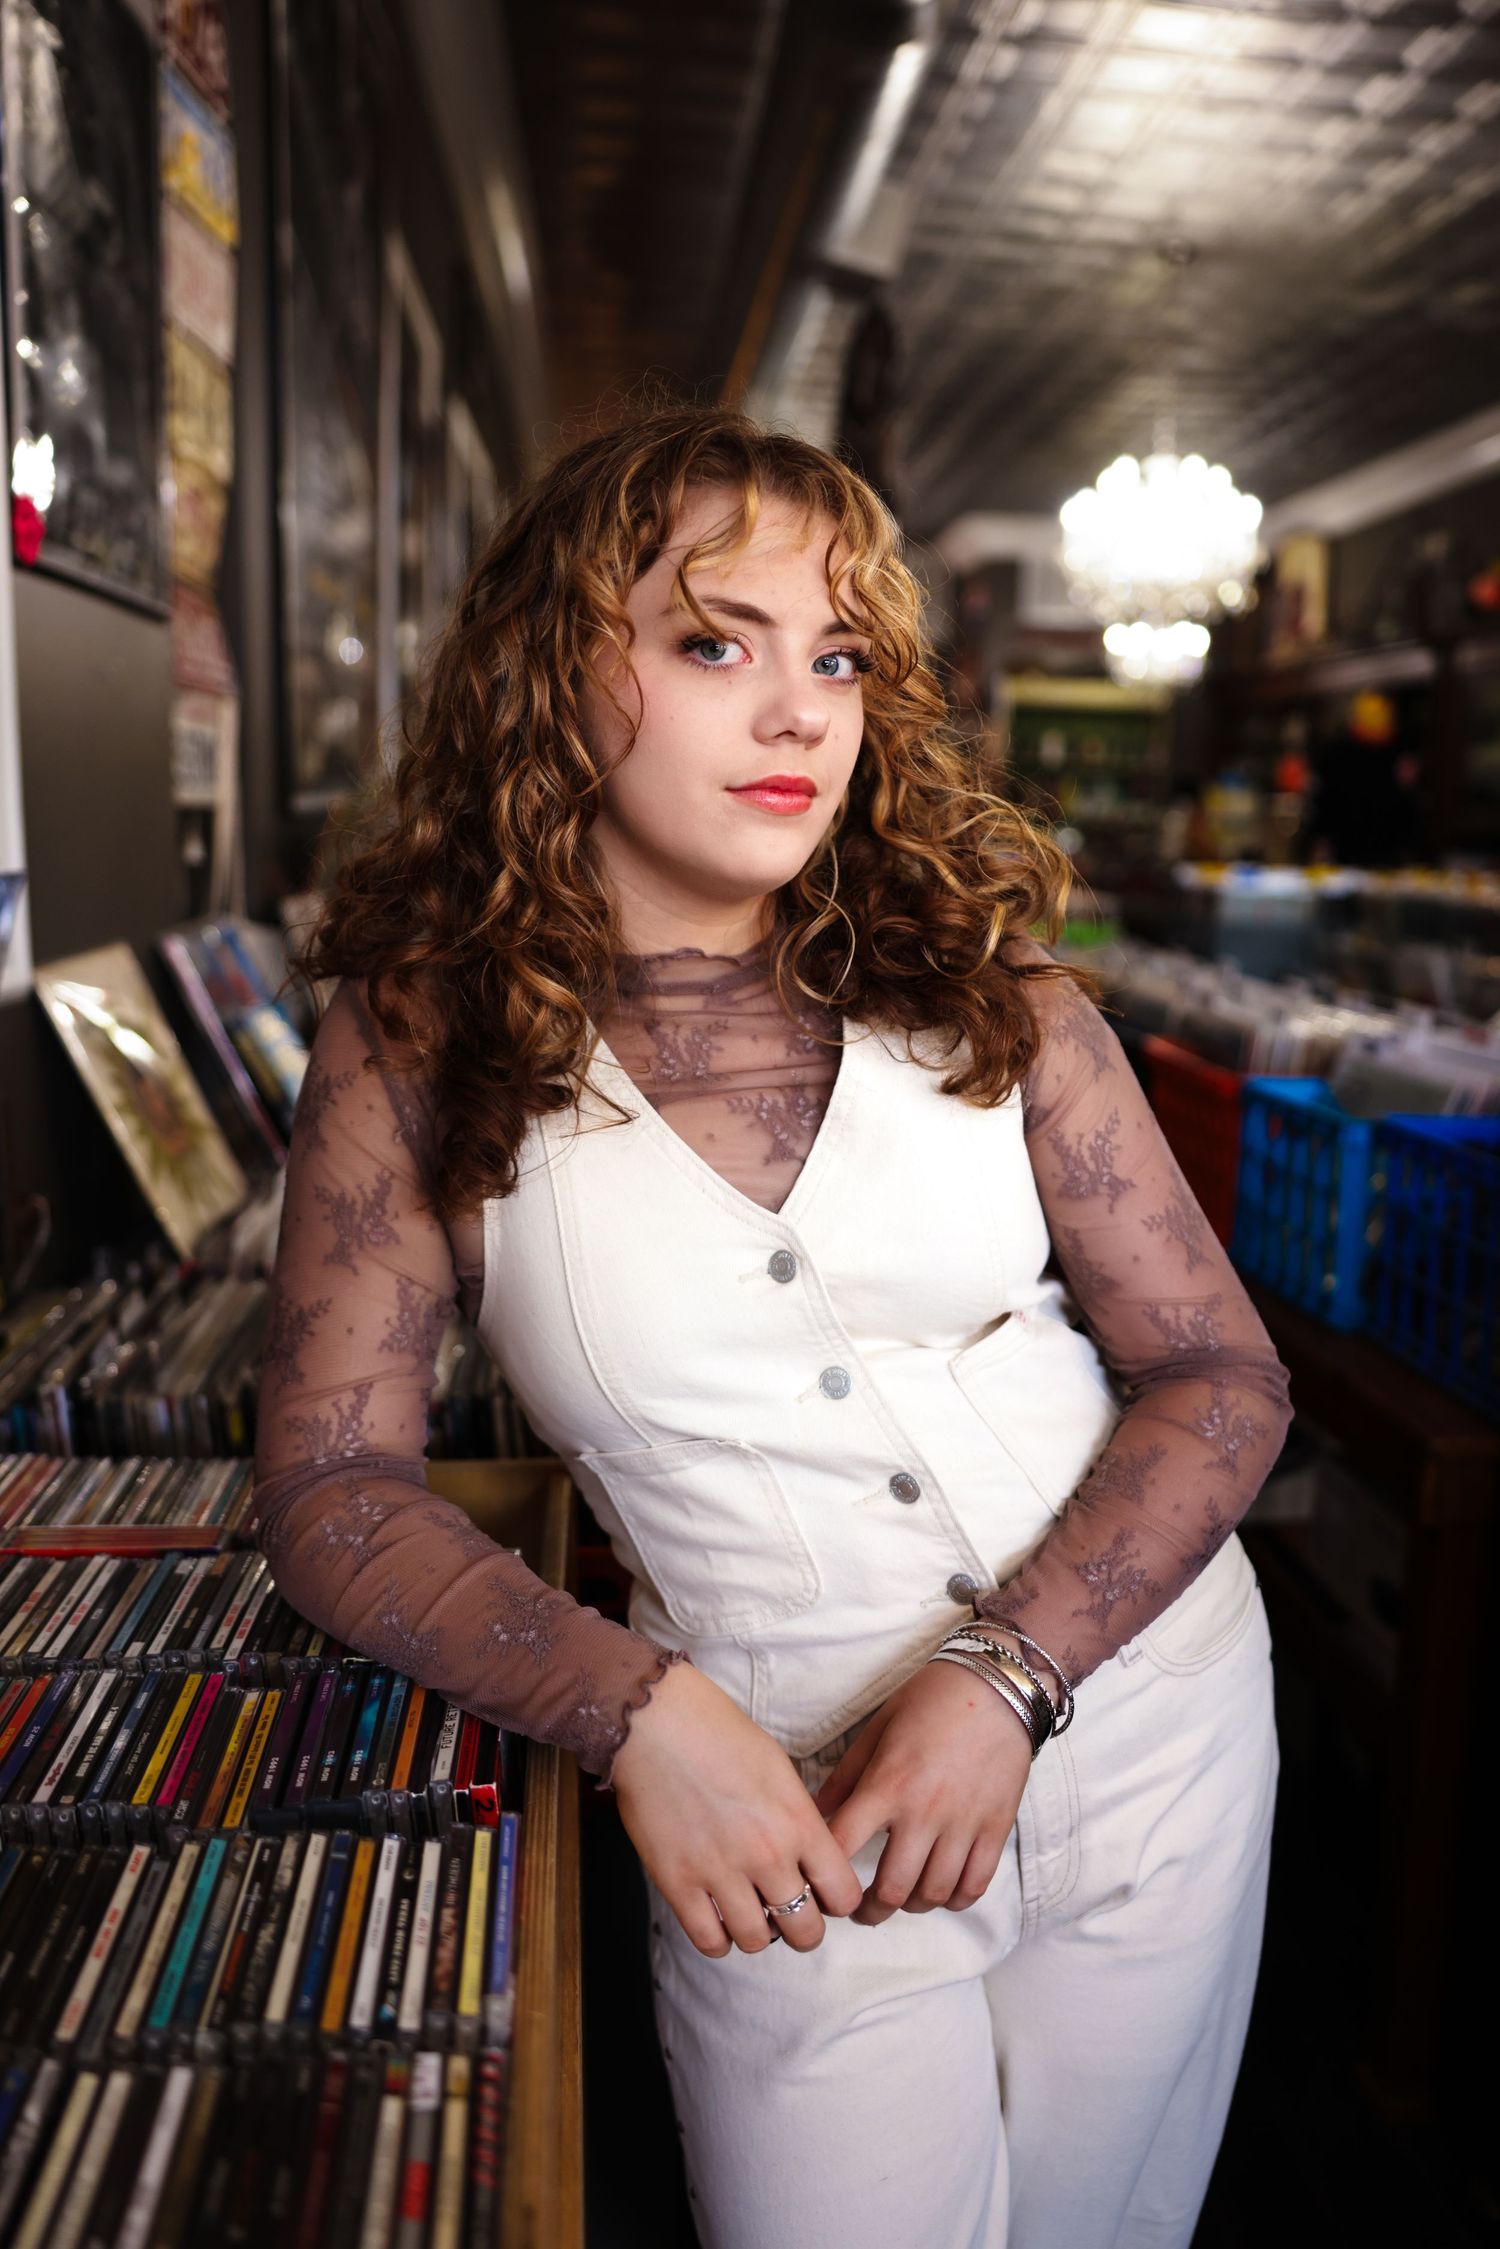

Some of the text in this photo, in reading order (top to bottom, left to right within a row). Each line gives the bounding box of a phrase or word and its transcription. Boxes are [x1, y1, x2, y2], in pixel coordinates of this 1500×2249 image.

[441, 1723, 456, 1749] FUTURE
[296, 1772, 305, 1787] NOW
[320, 1766, 330, 1781] NOW
[350, 1766, 360, 1781] NOW
[263, 1774, 273, 1789] NOW
